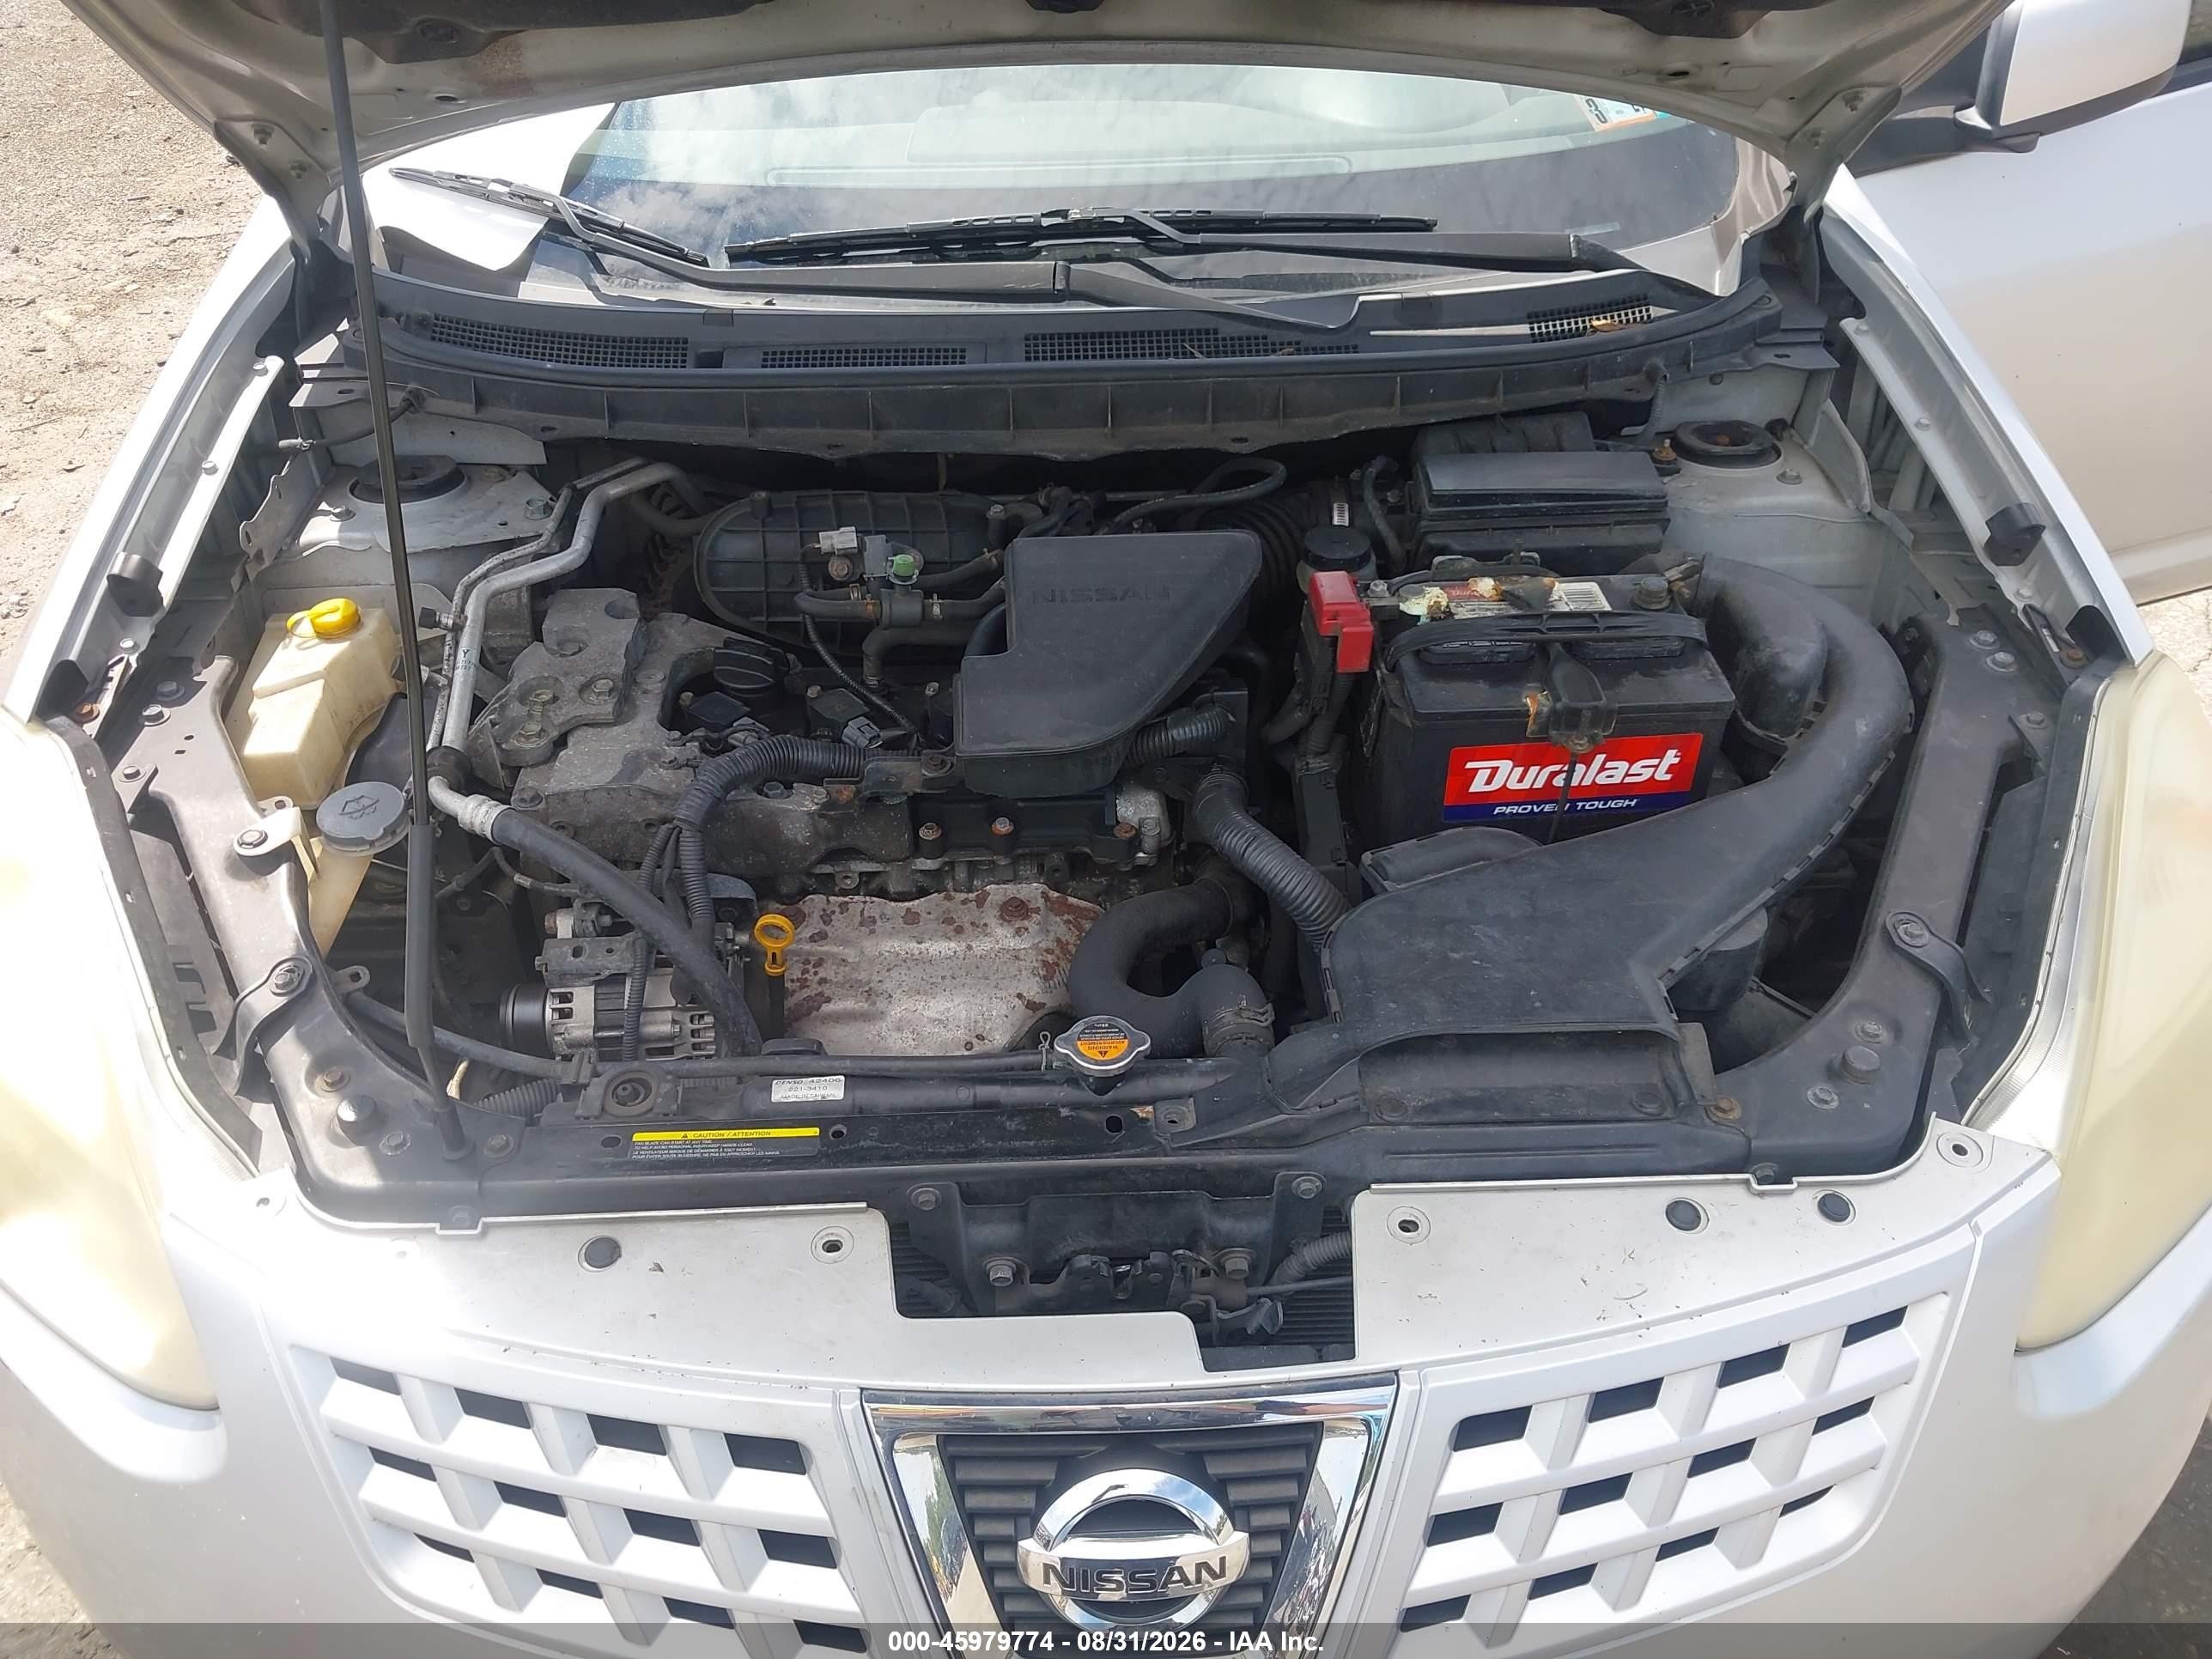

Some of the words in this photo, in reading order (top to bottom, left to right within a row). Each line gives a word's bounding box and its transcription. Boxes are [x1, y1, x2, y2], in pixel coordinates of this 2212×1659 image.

[1030, 586, 1170, 605] NISSAN
[1464, 749, 1680, 793] Duralast
[1576, 799, 1638, 811] TOUGH
[1042, 1555, 1227, 1595] NISSAN
